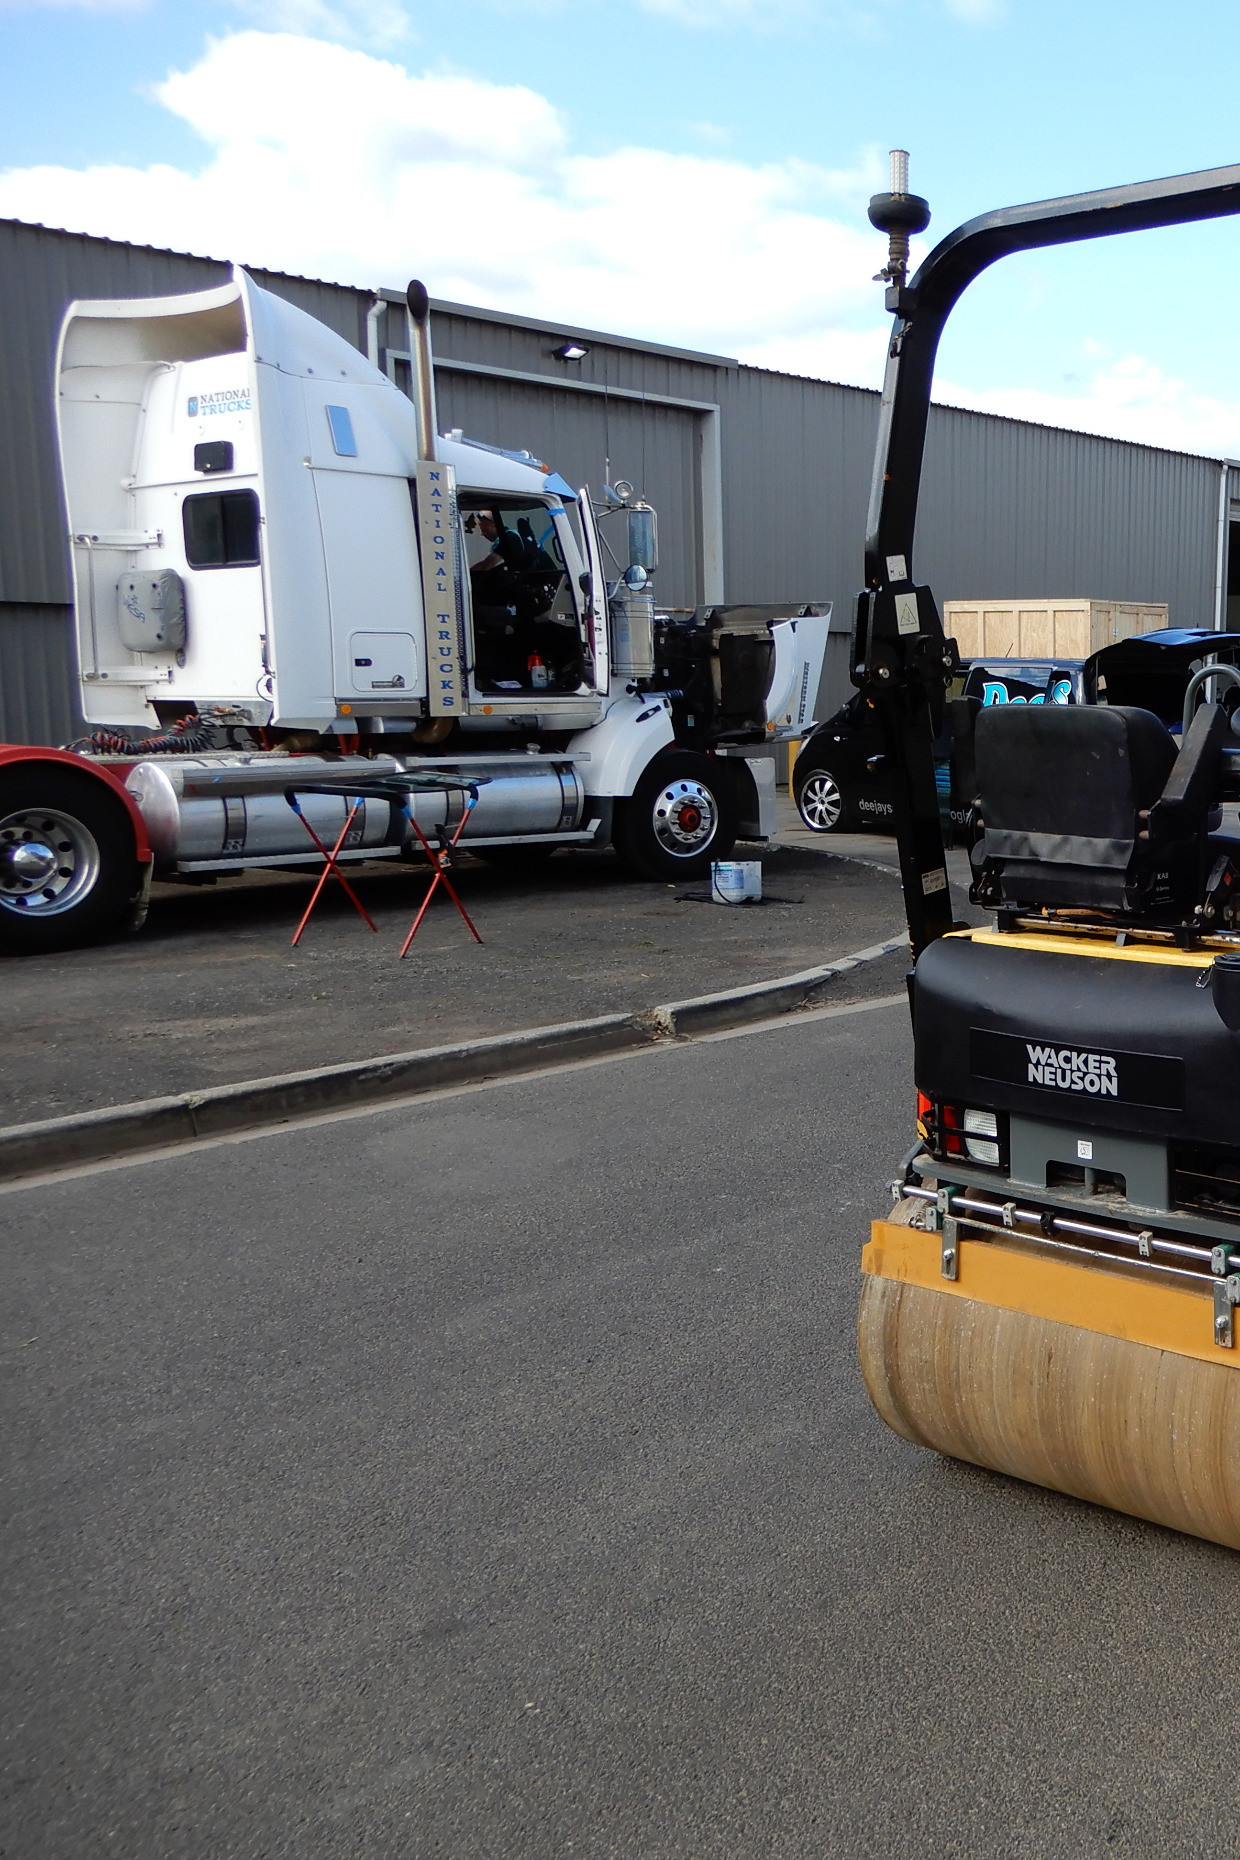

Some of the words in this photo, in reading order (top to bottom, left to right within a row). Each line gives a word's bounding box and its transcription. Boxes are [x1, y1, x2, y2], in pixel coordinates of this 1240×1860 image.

[200, 399, 252, 416] TRUCKS
[429, 471, 447, 592] NATIONAL
[437, 613, 455, 706] TRUCKS
[859, 799, 893, 815] deejays
[1026, 1044, 1118, 1076] WACKER
[1028, 1063, 1118, 1096] NEUSON
